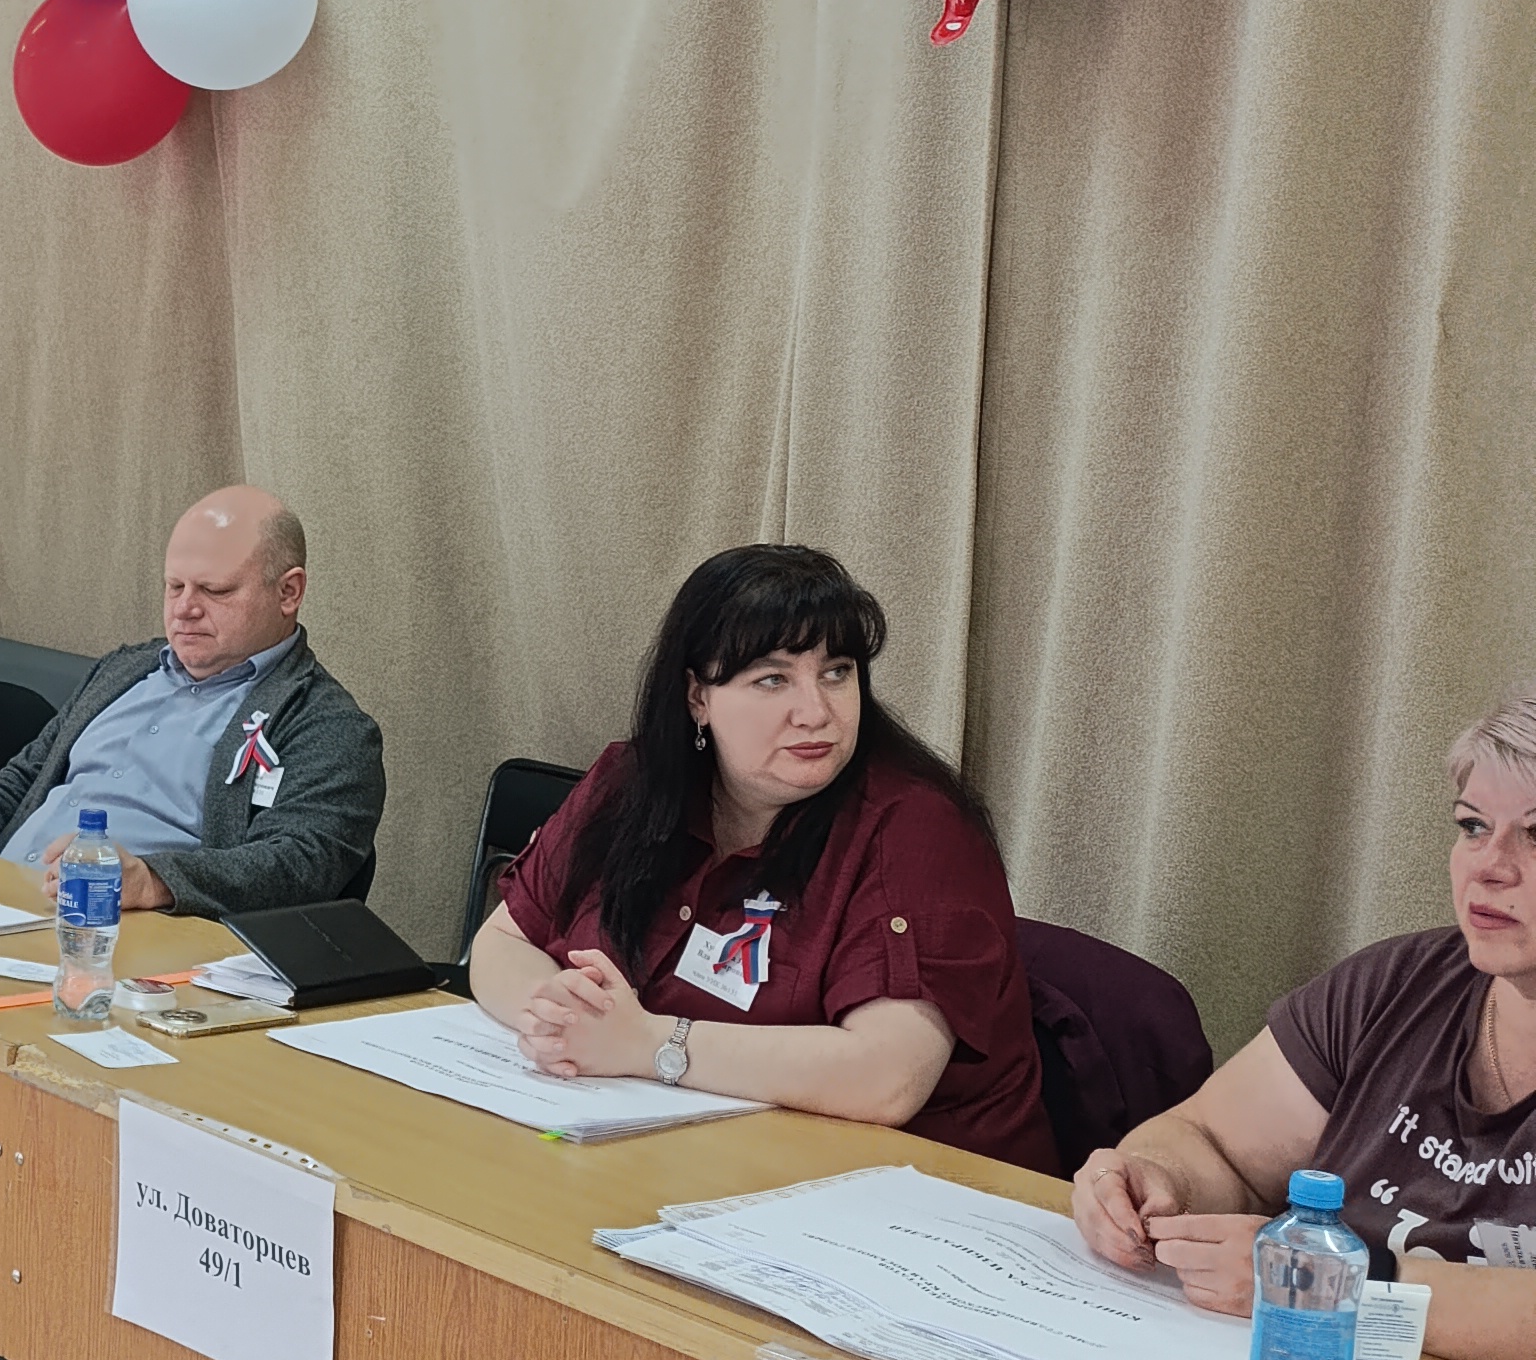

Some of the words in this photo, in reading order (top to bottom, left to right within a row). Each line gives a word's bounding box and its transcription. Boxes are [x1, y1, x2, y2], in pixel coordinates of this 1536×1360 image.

[1388, 1105, 1420, 1143] it
[1498, 1151, 1536, 1185] wi
[136, 1182, 168, 1211] ул.
[173, 1192, 311, 1276] Доваторцев
[199, 1248, 242, 1289] 49/1
